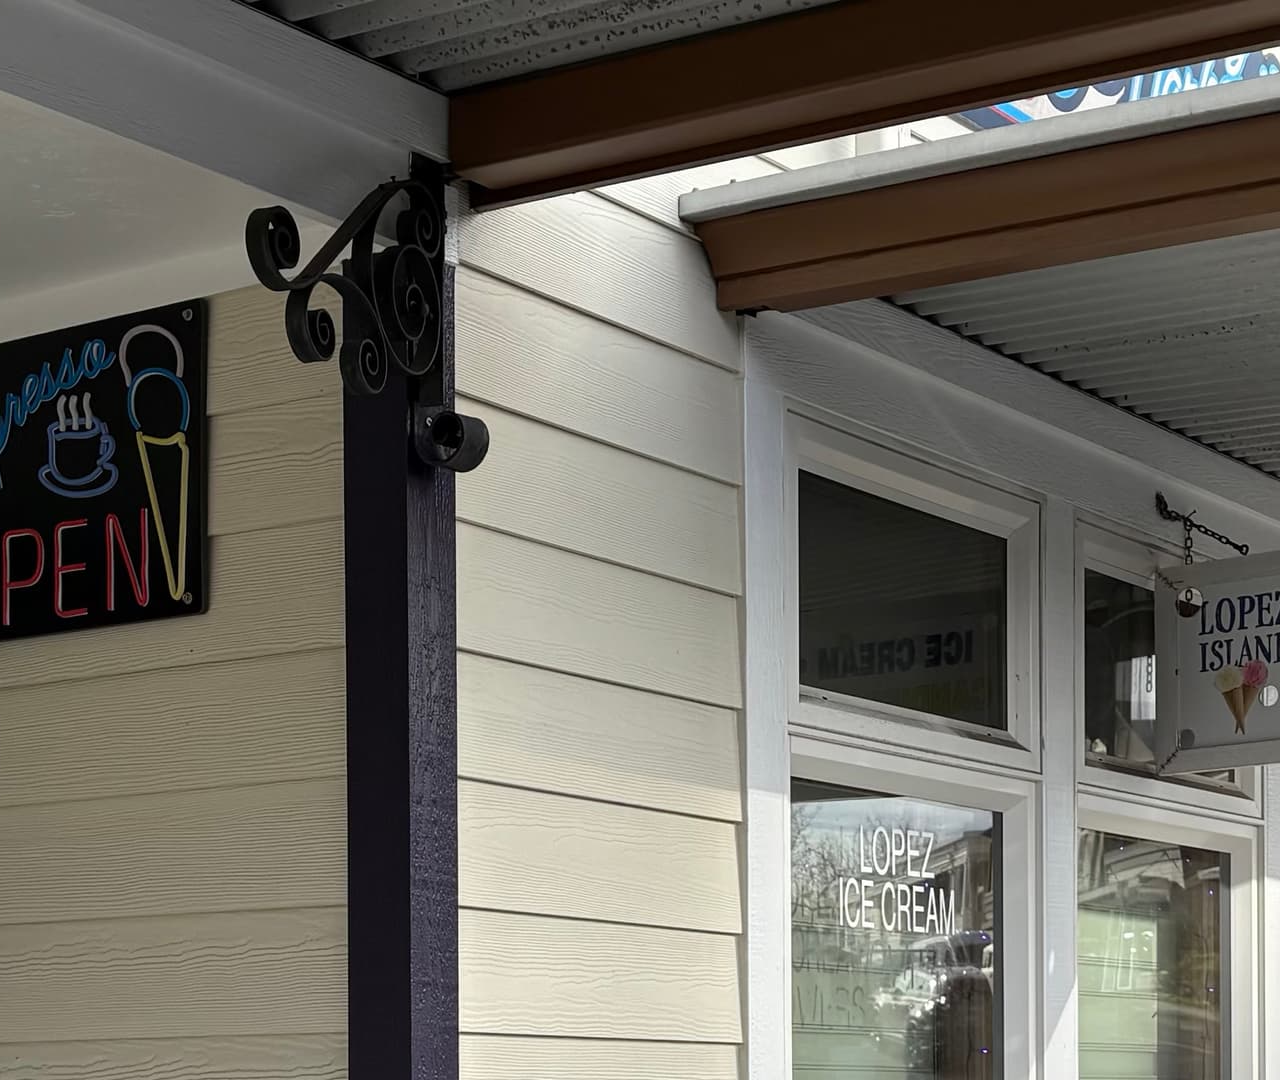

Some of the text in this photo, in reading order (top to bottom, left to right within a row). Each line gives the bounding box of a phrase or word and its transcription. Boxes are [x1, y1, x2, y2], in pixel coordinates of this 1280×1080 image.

[860, 824, 935, 878] LOPEZ
[839, 876, 875, 928] ICE
[881, 881, 956, 935] CREAM
